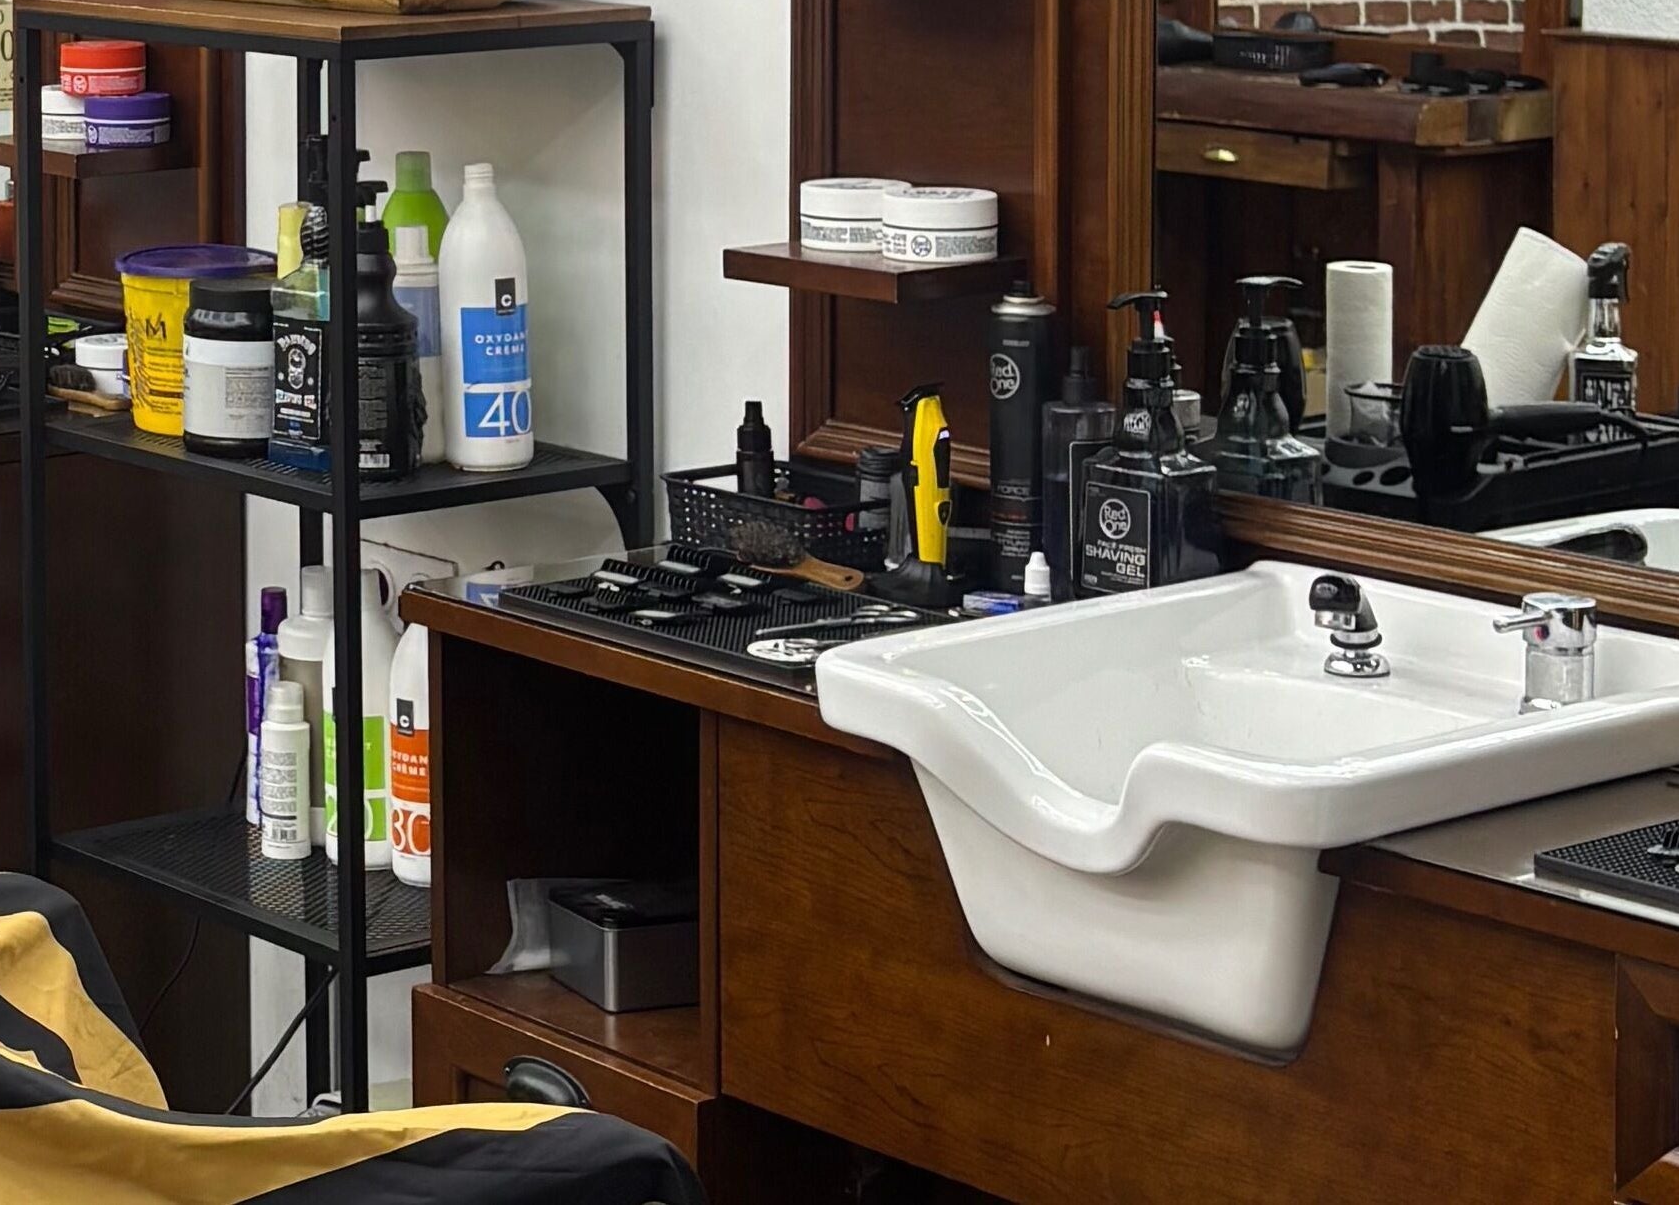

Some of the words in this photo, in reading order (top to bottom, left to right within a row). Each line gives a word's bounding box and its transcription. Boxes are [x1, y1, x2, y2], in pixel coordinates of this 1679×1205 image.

[478, 389, 532, 437] 40
[1086, 544, 1145, 565] SHAVING
[1116, 563, 1145, 578] GEL
